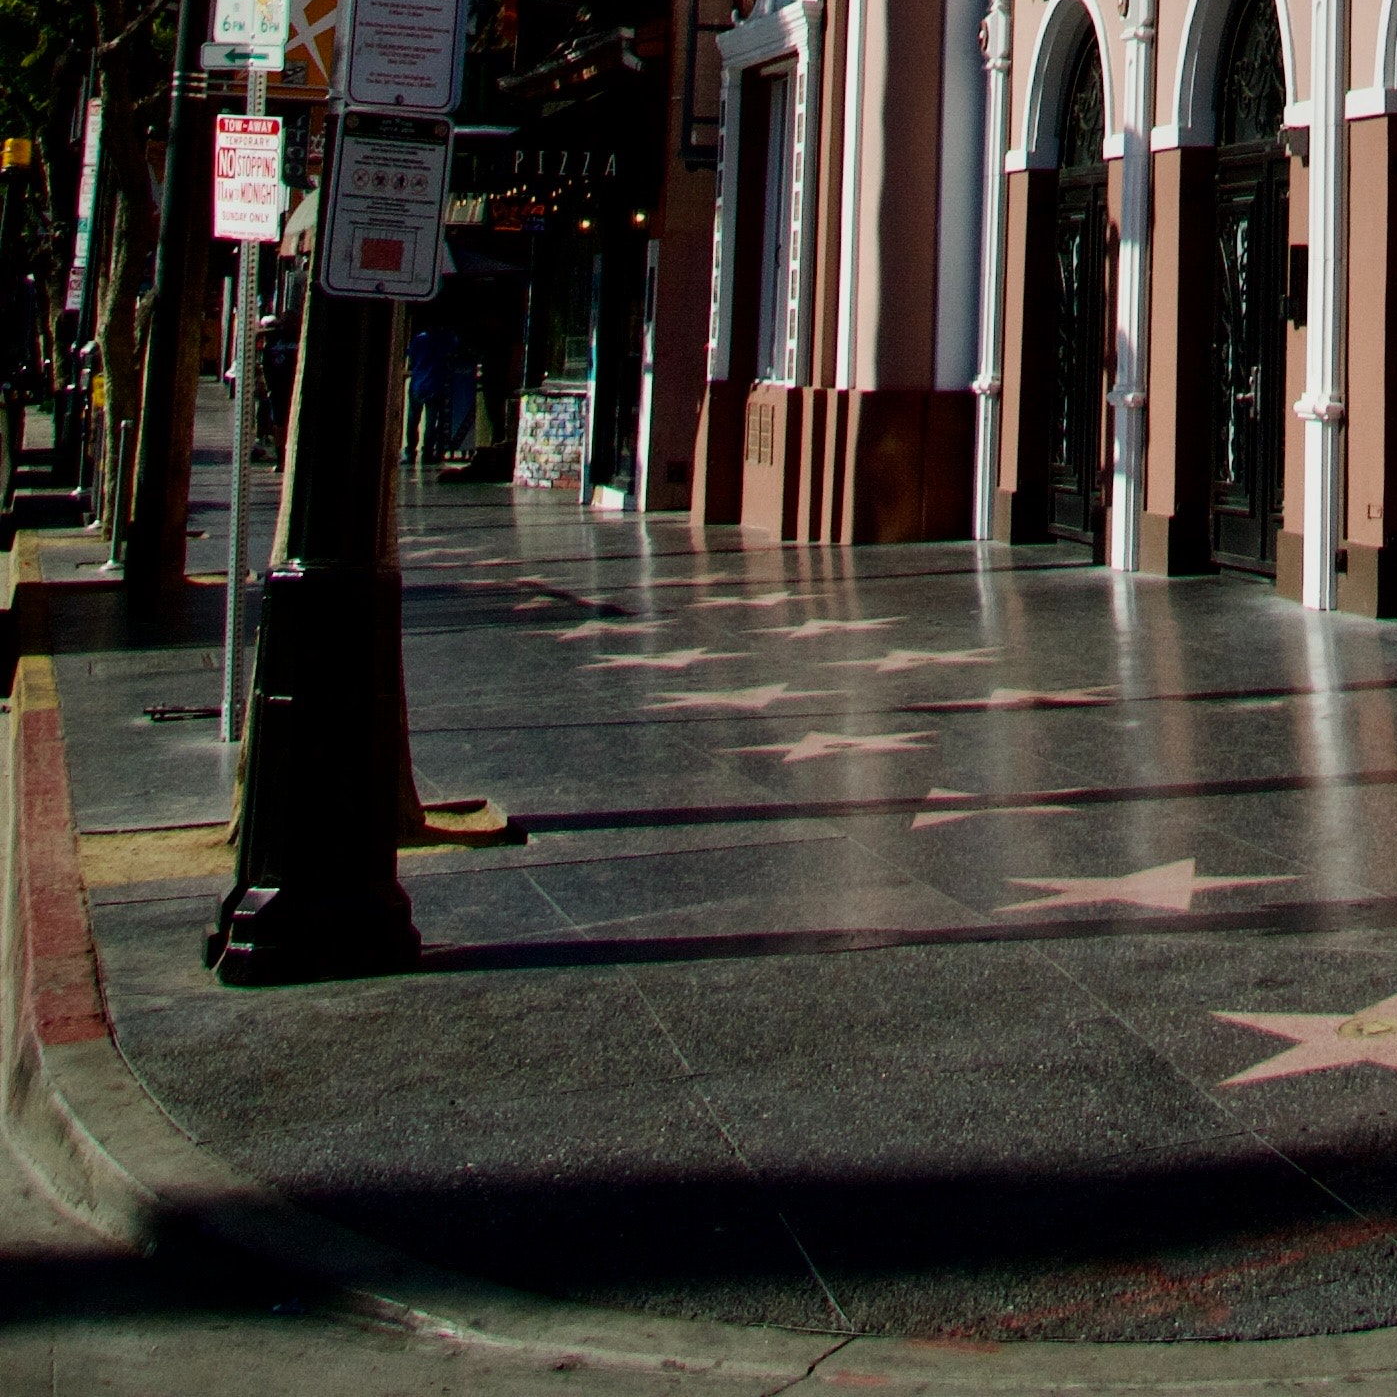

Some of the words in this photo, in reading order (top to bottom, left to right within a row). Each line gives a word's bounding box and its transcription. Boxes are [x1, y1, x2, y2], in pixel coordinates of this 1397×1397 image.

[224, 119, 273, 134] TOW-AWAY
[225, 136, 270, 147] TEMPORARY
[219, 149, 235, 178] NO
[237, 155, 276, 179] STOPPING
[514, 149, 617, 177] PIZZA
[240, 182, 277, 205] MIDNIGHT
[222, 210, 247, 222] SUNDAY
[249, 212, 270, 224] ONLY
